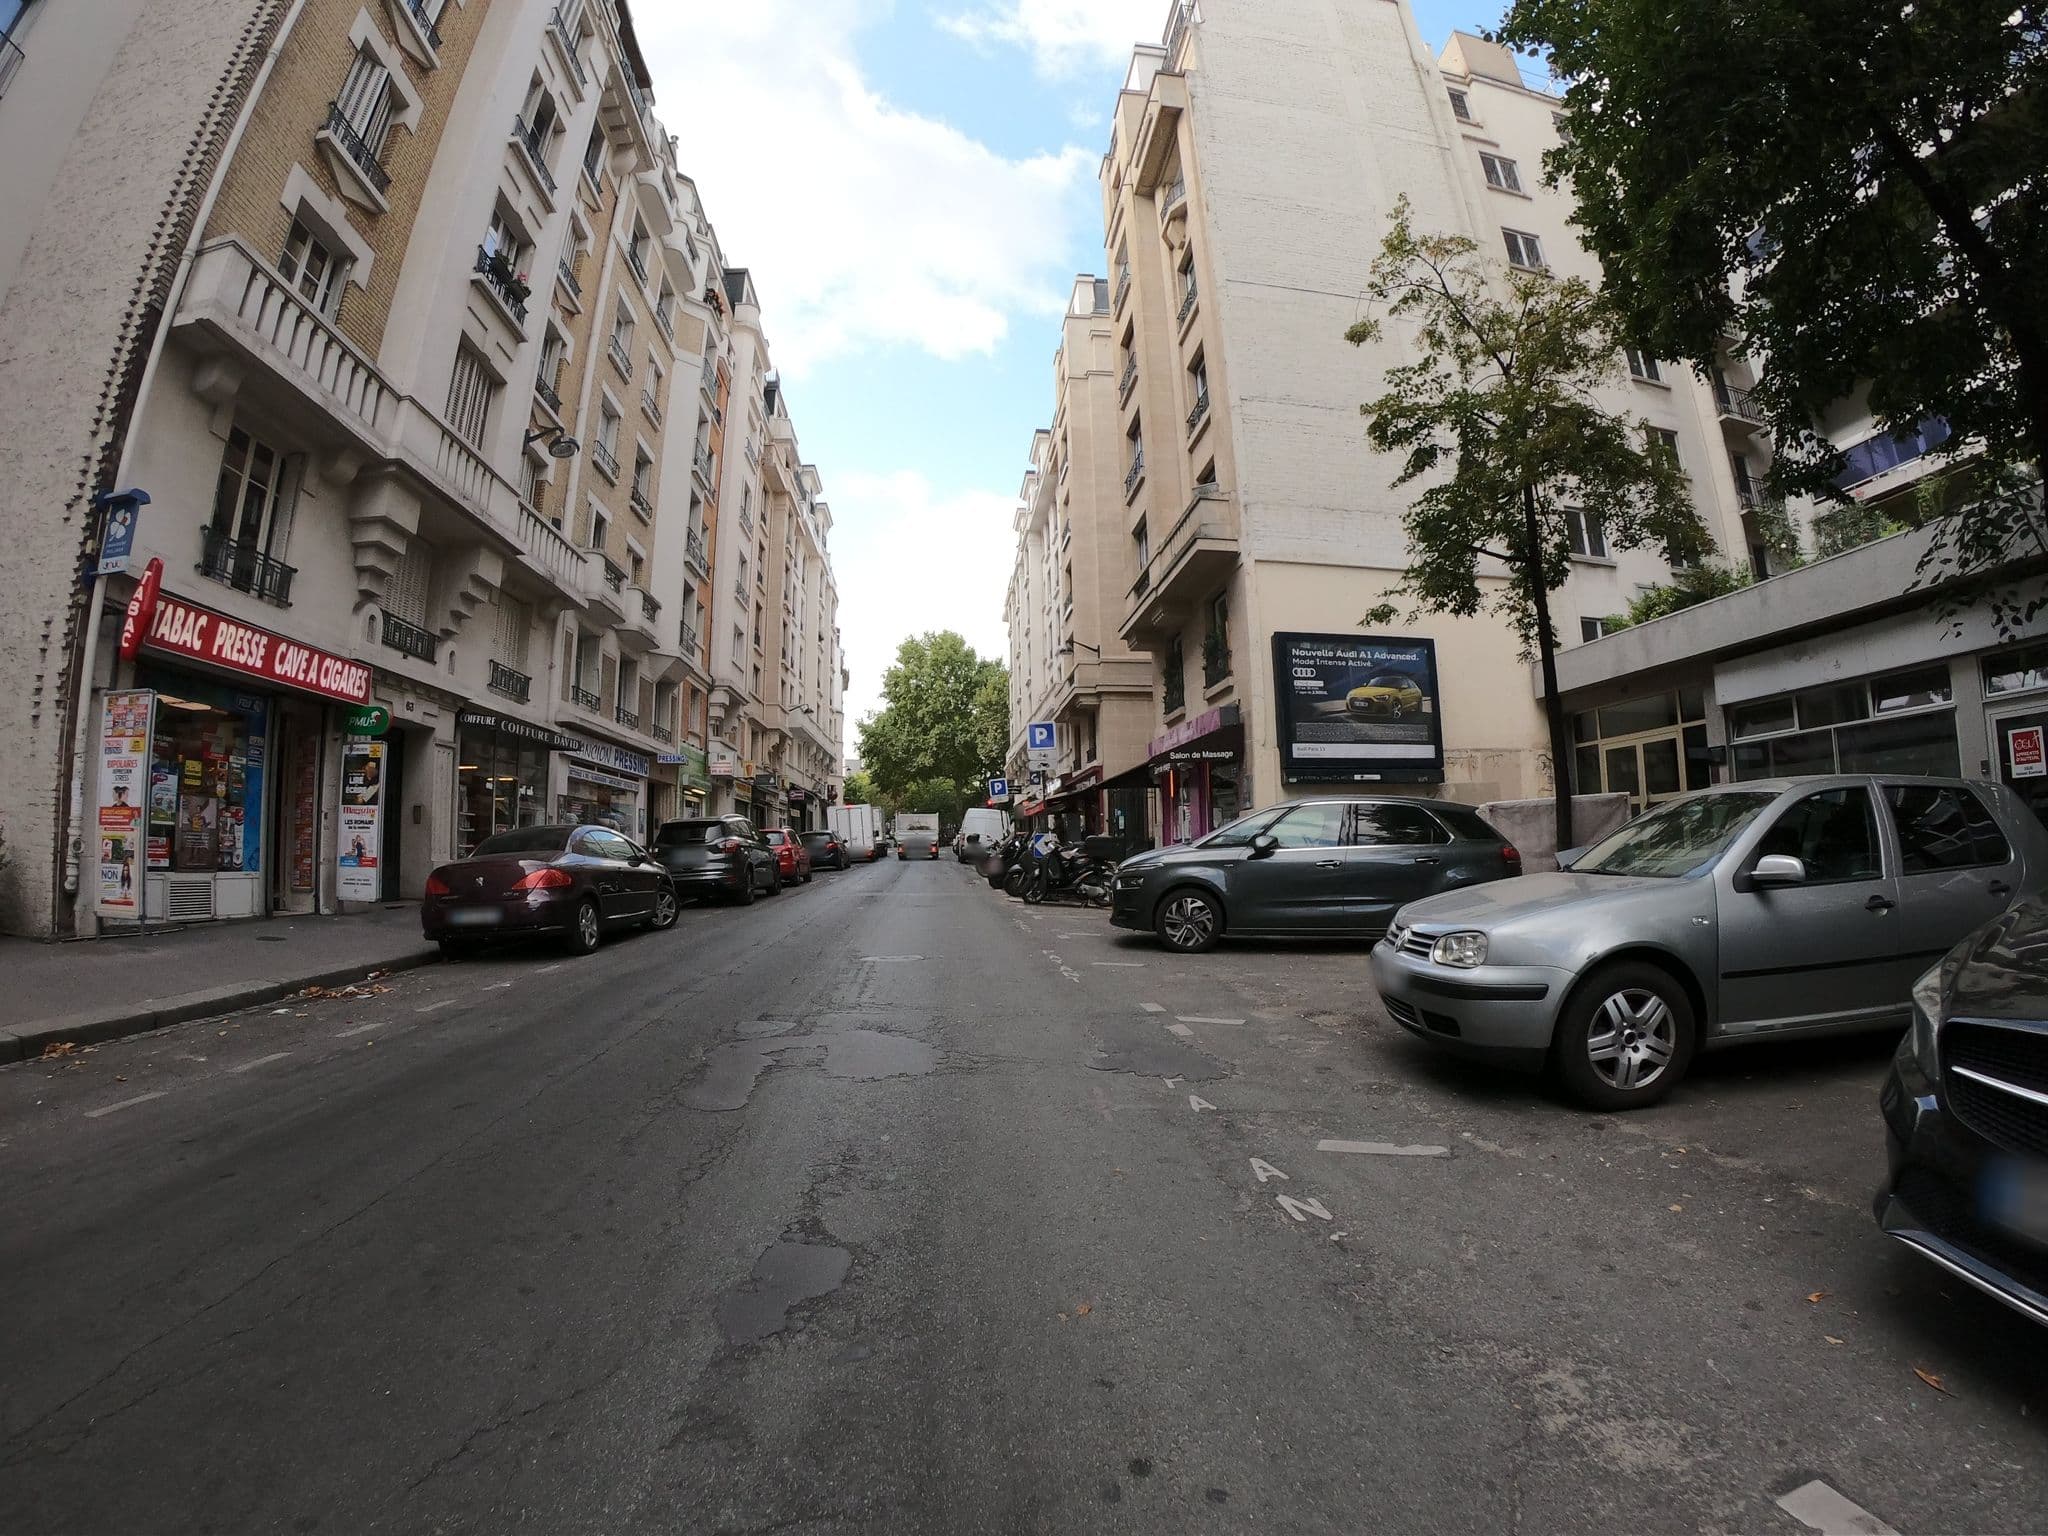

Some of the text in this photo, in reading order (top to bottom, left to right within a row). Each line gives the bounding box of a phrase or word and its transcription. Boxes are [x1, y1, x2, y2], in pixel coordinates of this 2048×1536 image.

[121, 570, 152, 648] TABAC
[151, 600, 368, 699] TABAC PRESSE CAVE A CIGARES
[1291, 648, 1420, 661] Nouvelle Audi A1 Advanced.
[1292, 658, 1315, 666] Mode
[1316, 658, 1347, 667] Intense
[348, 717, 371, 727] PMU
[460, 713, 497, 726] COIFFURE
[501, 720, 579, 750] COIFFURE DAVID
[1035, 727, 1048, 745] P
[614, 748, 649, 775] PRESSING
[1170, 751, 1190, 760] Salon
[1202, 750, 1234, 760] Massage
[994, 781, 1004, 793] P
[101, 870, 119, 880] NON
